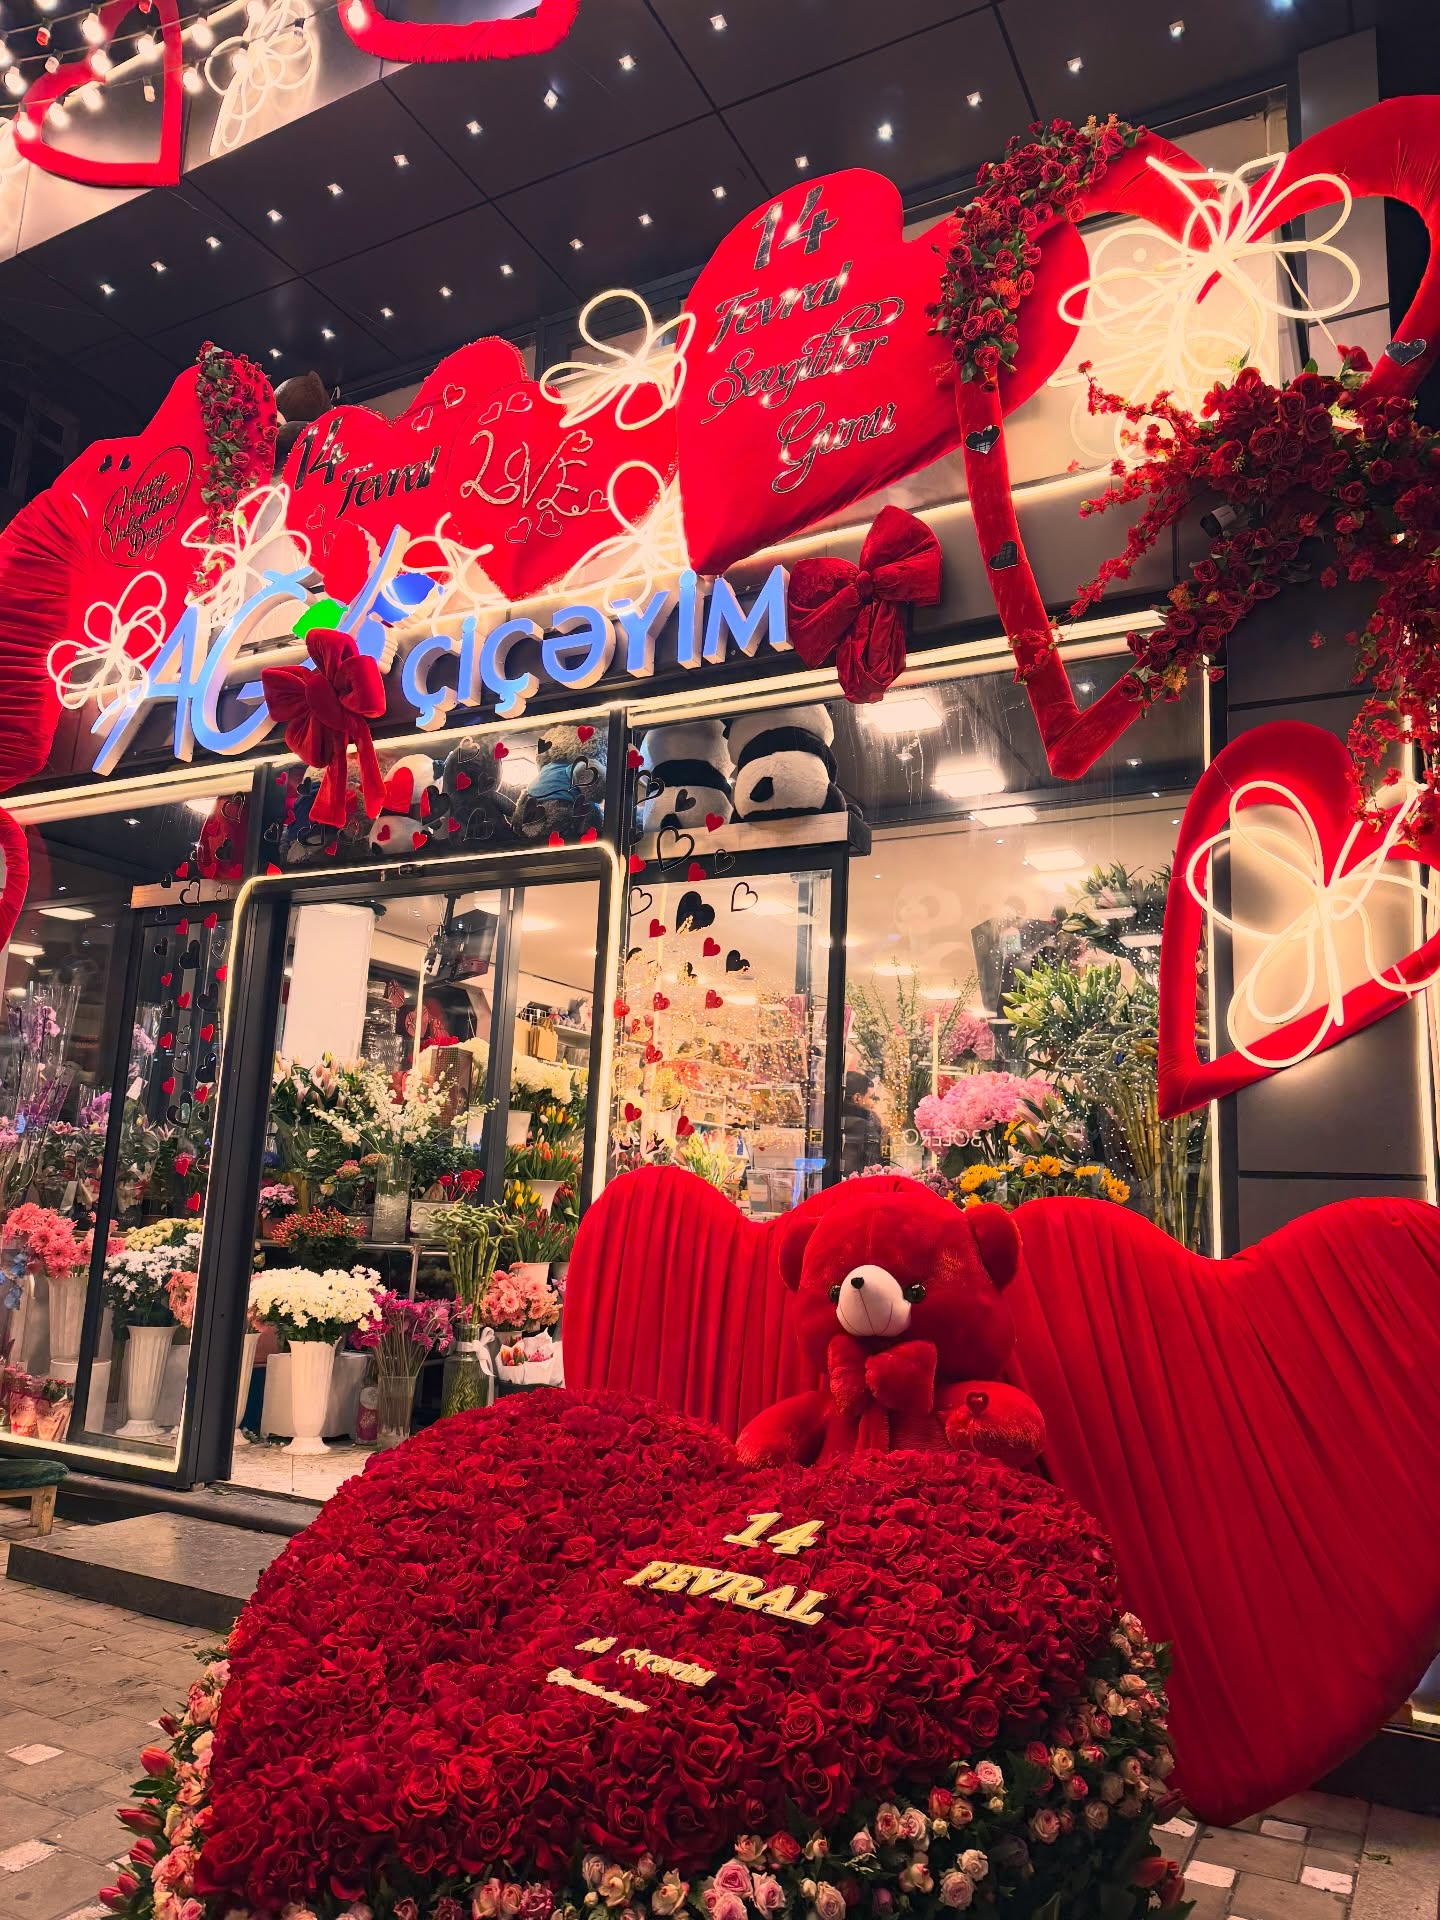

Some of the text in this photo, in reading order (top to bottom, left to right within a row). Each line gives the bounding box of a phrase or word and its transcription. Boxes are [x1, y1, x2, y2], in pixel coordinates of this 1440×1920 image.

[752, 185, 839, 271] 14
[708, 260, 853, 353] Fevral
[103, 471, 171, 525] Happy
[294, 416, 442, 519] 14 Fevral
[127, 518, 176, 561] Day
[401, 565, 792, 732] ÇİÇƏYİM
[723, 1511, 825, 1556] 14
[622, 1560, 829, 1626] FEVRAL
